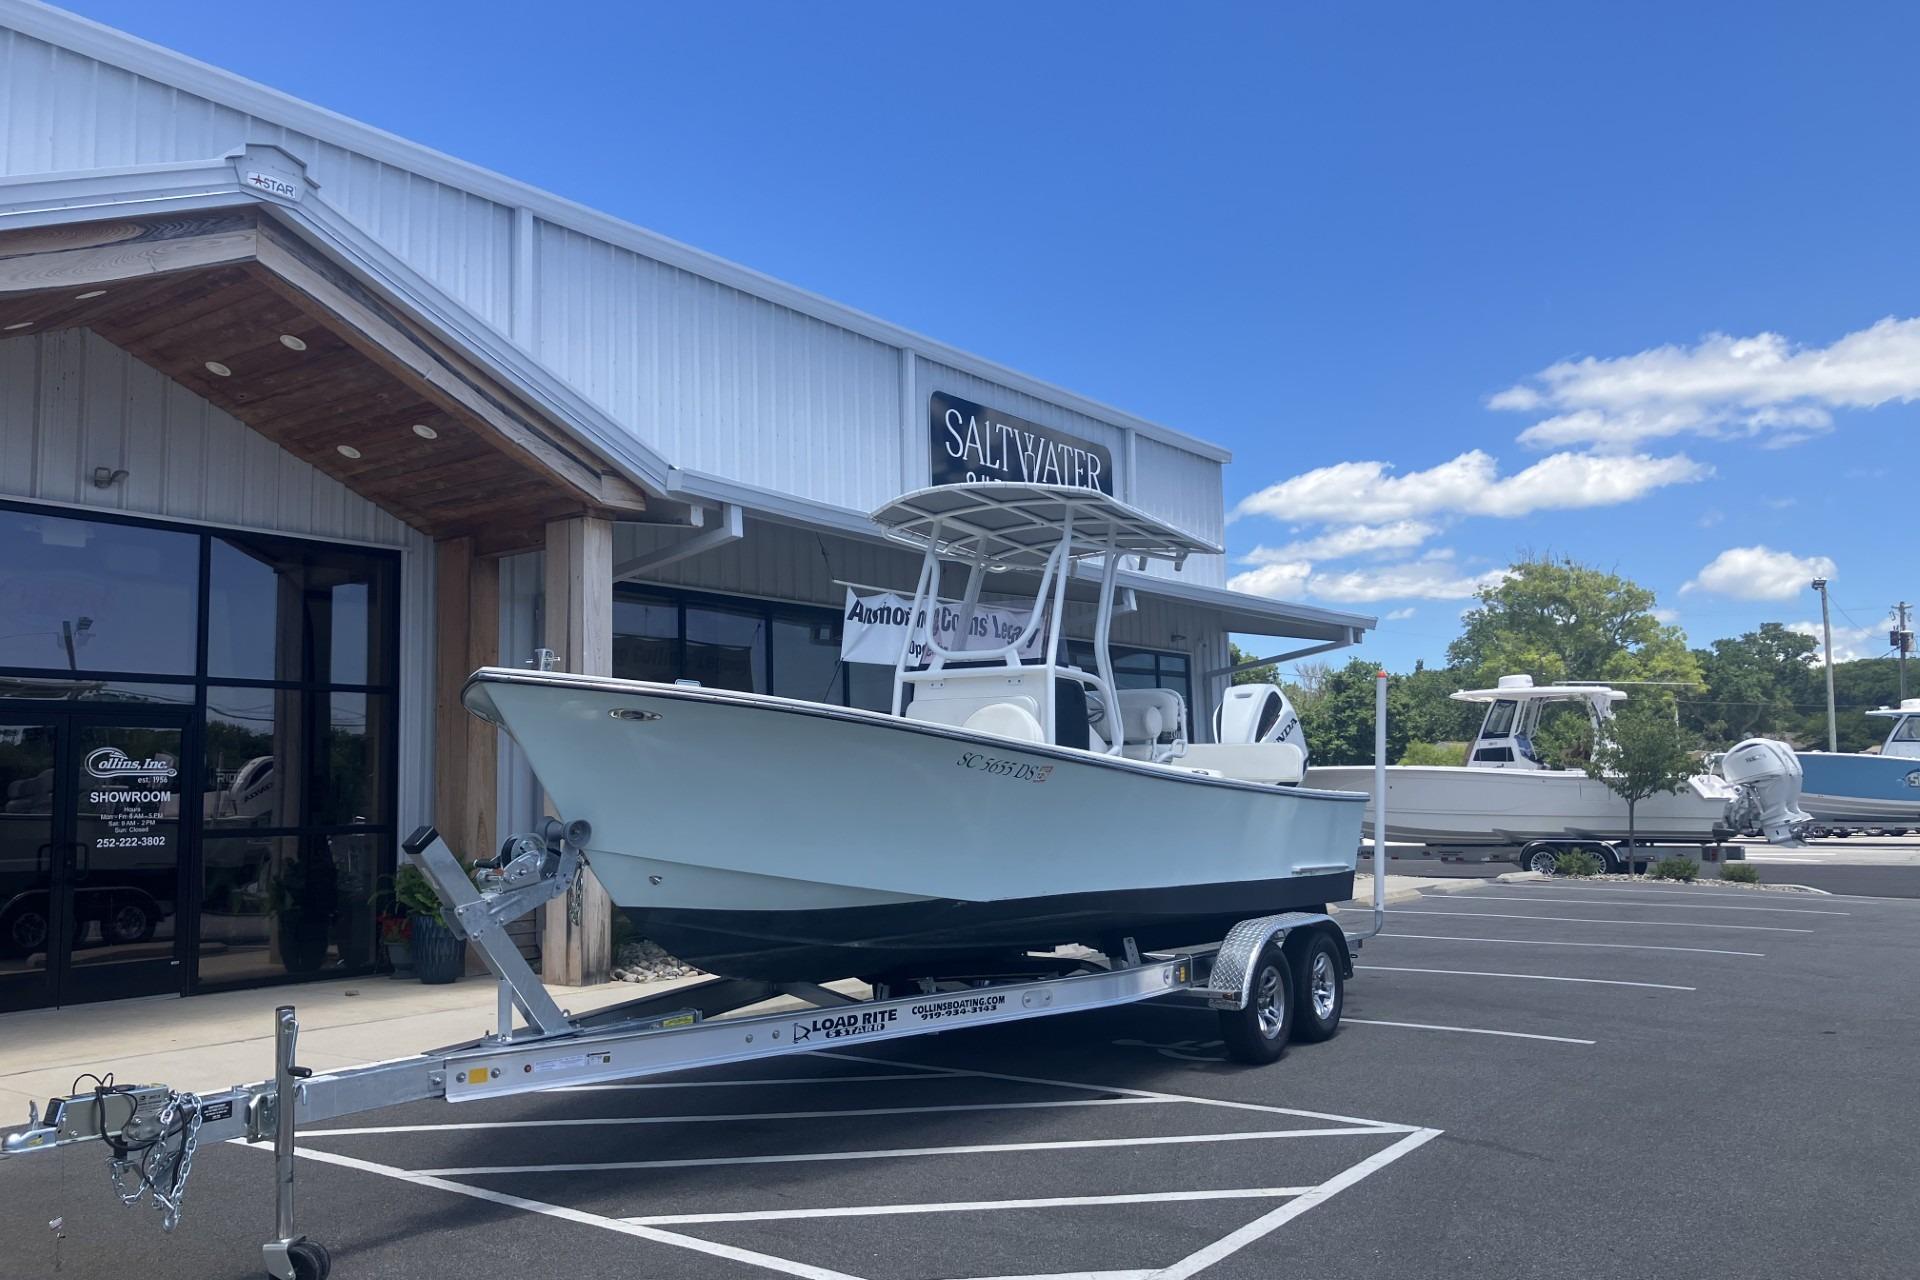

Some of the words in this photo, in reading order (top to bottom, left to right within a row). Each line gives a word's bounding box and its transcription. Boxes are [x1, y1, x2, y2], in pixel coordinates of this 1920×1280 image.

[263, 178, 294, 196] STAR
[945, 408, 1101, 491] SALTWATER
[847, 599, 940, 637] Anchorng
[992, 615, 1040, 649] Legay
[1275, 717, 1297, 742] NDA
[143, 758, 168, 769] Inc.
[957, 751, 984, 769] SC
[979, 758, 1018, 776] 5655
[1013, 763, 1039, 781] DS
[138, 776, 151, 784] est.
[153, 775, 168, 784] 1956
[90, 791, 171, 803] SHOWROOM
[96, 836, 166, 848] 252-222-3802
[911, 995, 1006, 1015] COLLINSBOATING.COM
[920, 1005, 997, 1021] 919-934-3143
[812, 1014, 859, 1033] LOAD
[862, 1008, 898, 1025] RITE
